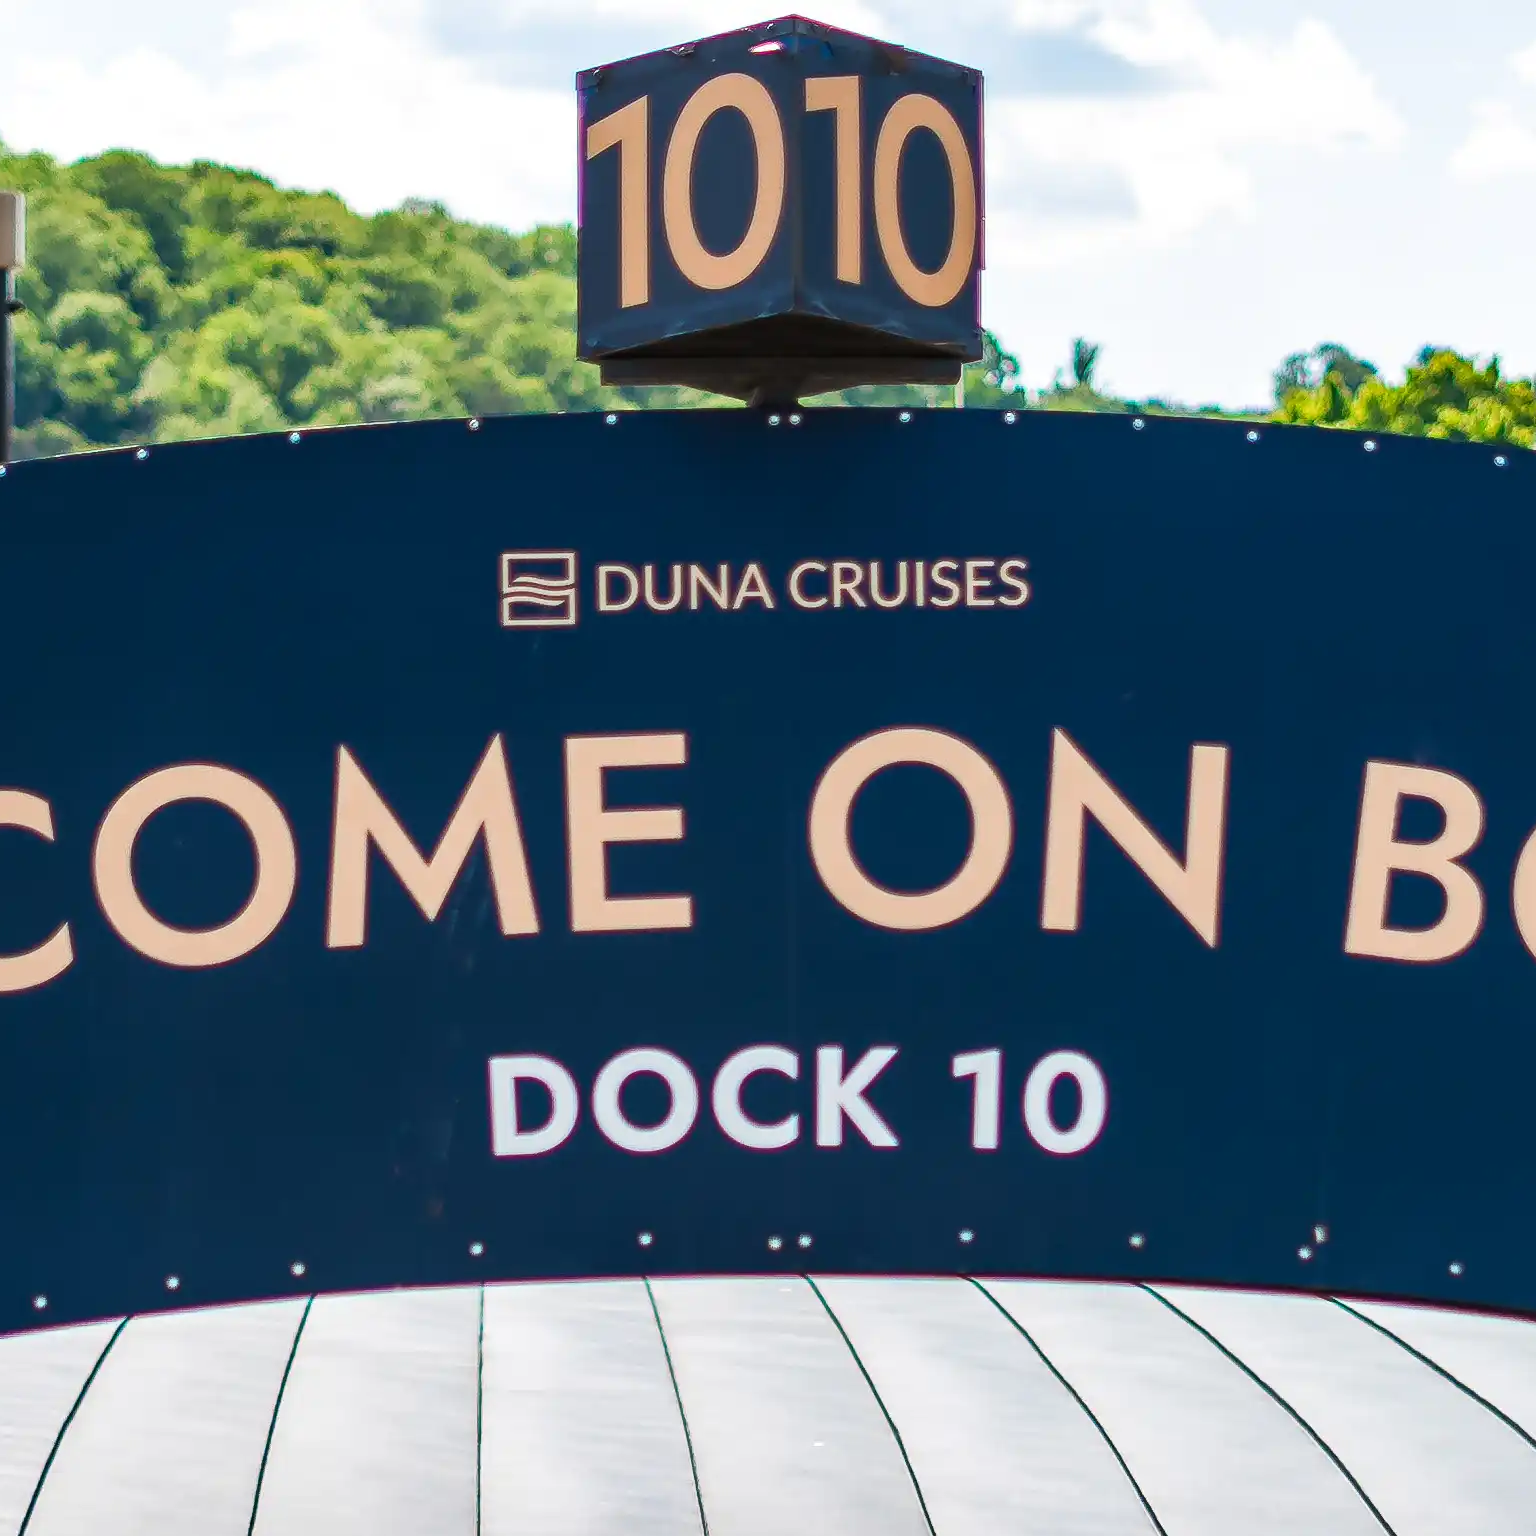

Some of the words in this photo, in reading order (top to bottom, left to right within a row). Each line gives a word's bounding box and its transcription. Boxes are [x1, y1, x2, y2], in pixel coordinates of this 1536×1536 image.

[586, 72, 785, 309] 10
[804, 75, 977, 307] 10
[597, 562, 775, 612] DUNA
[789, 559, 1030, 609] CRUISES
[808, 727, 1228, 948] ON
[487, 1043, 899, 1157] DOCK
[952, 1047, 1107, 1154] 10
